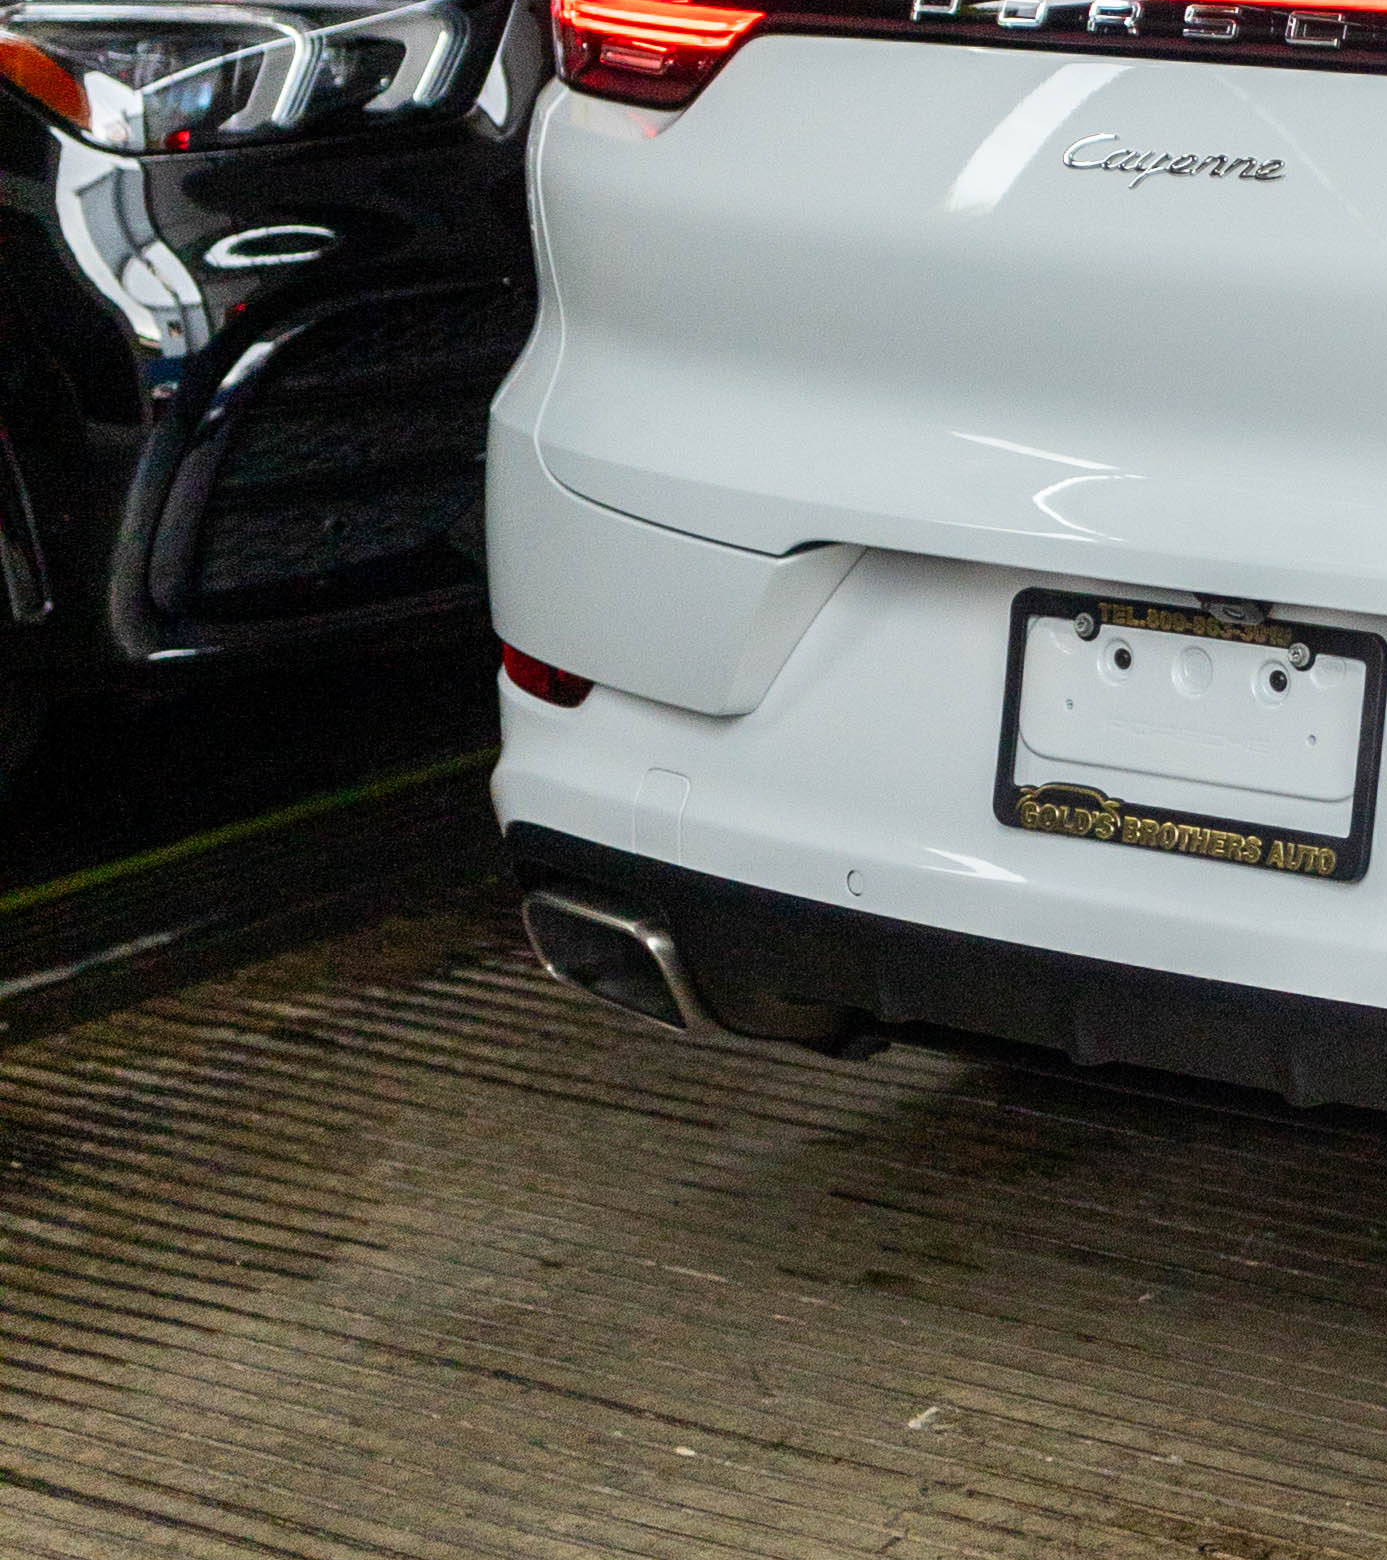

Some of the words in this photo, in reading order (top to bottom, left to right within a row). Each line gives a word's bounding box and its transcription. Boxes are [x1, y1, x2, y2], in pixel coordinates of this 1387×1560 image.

[1062, 133, 1286, 190] Cayenne
[1019, 799, 1116, 840] GOLD'S
[1121, 815, 1263, 864] BROTHERS
[1265, 838, 1337, 876] AUTO
